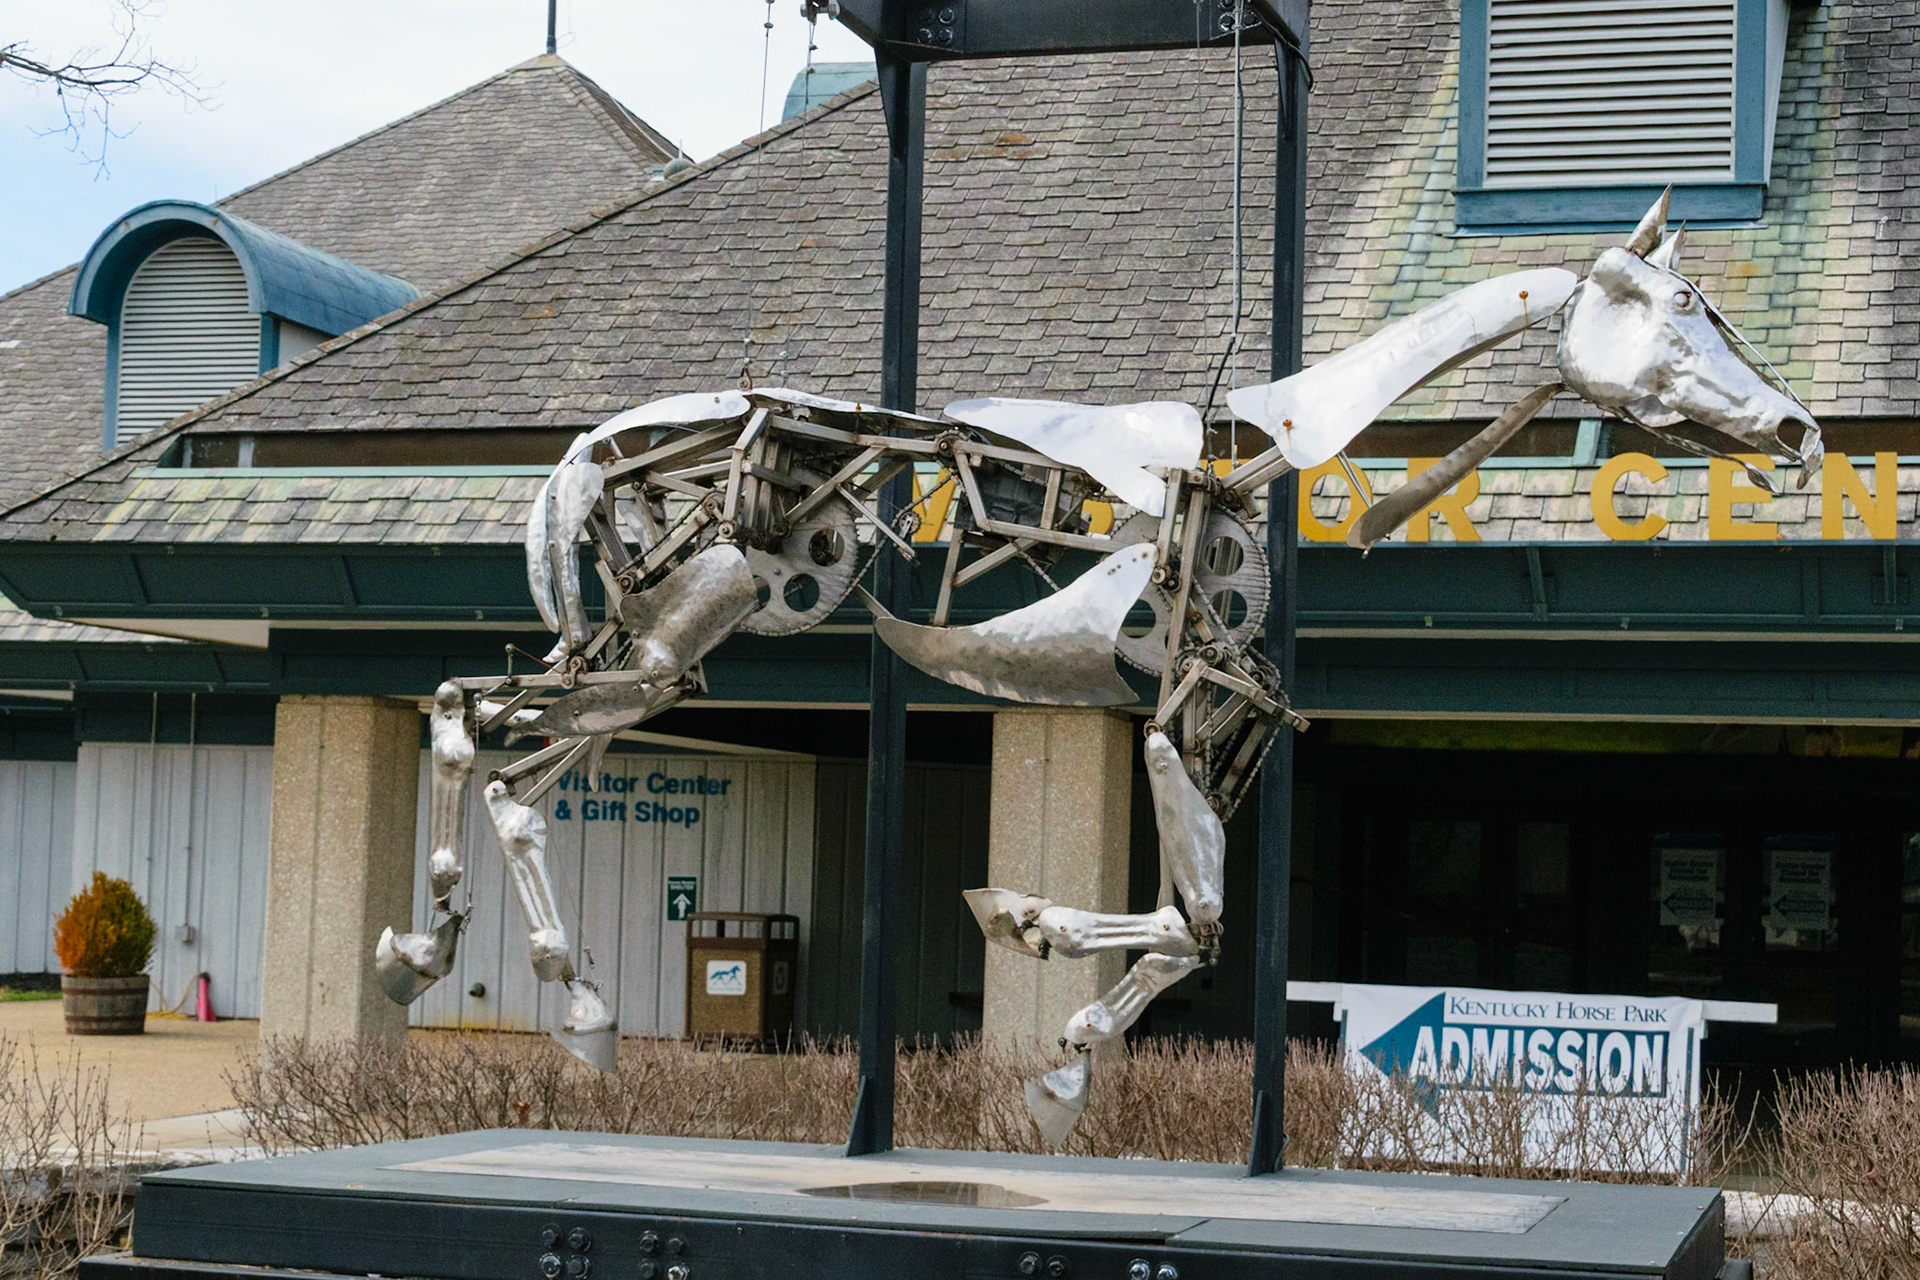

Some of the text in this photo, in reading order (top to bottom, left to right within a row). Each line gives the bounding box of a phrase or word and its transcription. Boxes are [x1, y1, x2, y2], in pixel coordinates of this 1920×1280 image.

[646, 772, 732, 795] Center
[555, 799, 700, 828] & Gift Shop
[1409, 1026, 1665, 1094] ADMISSION
